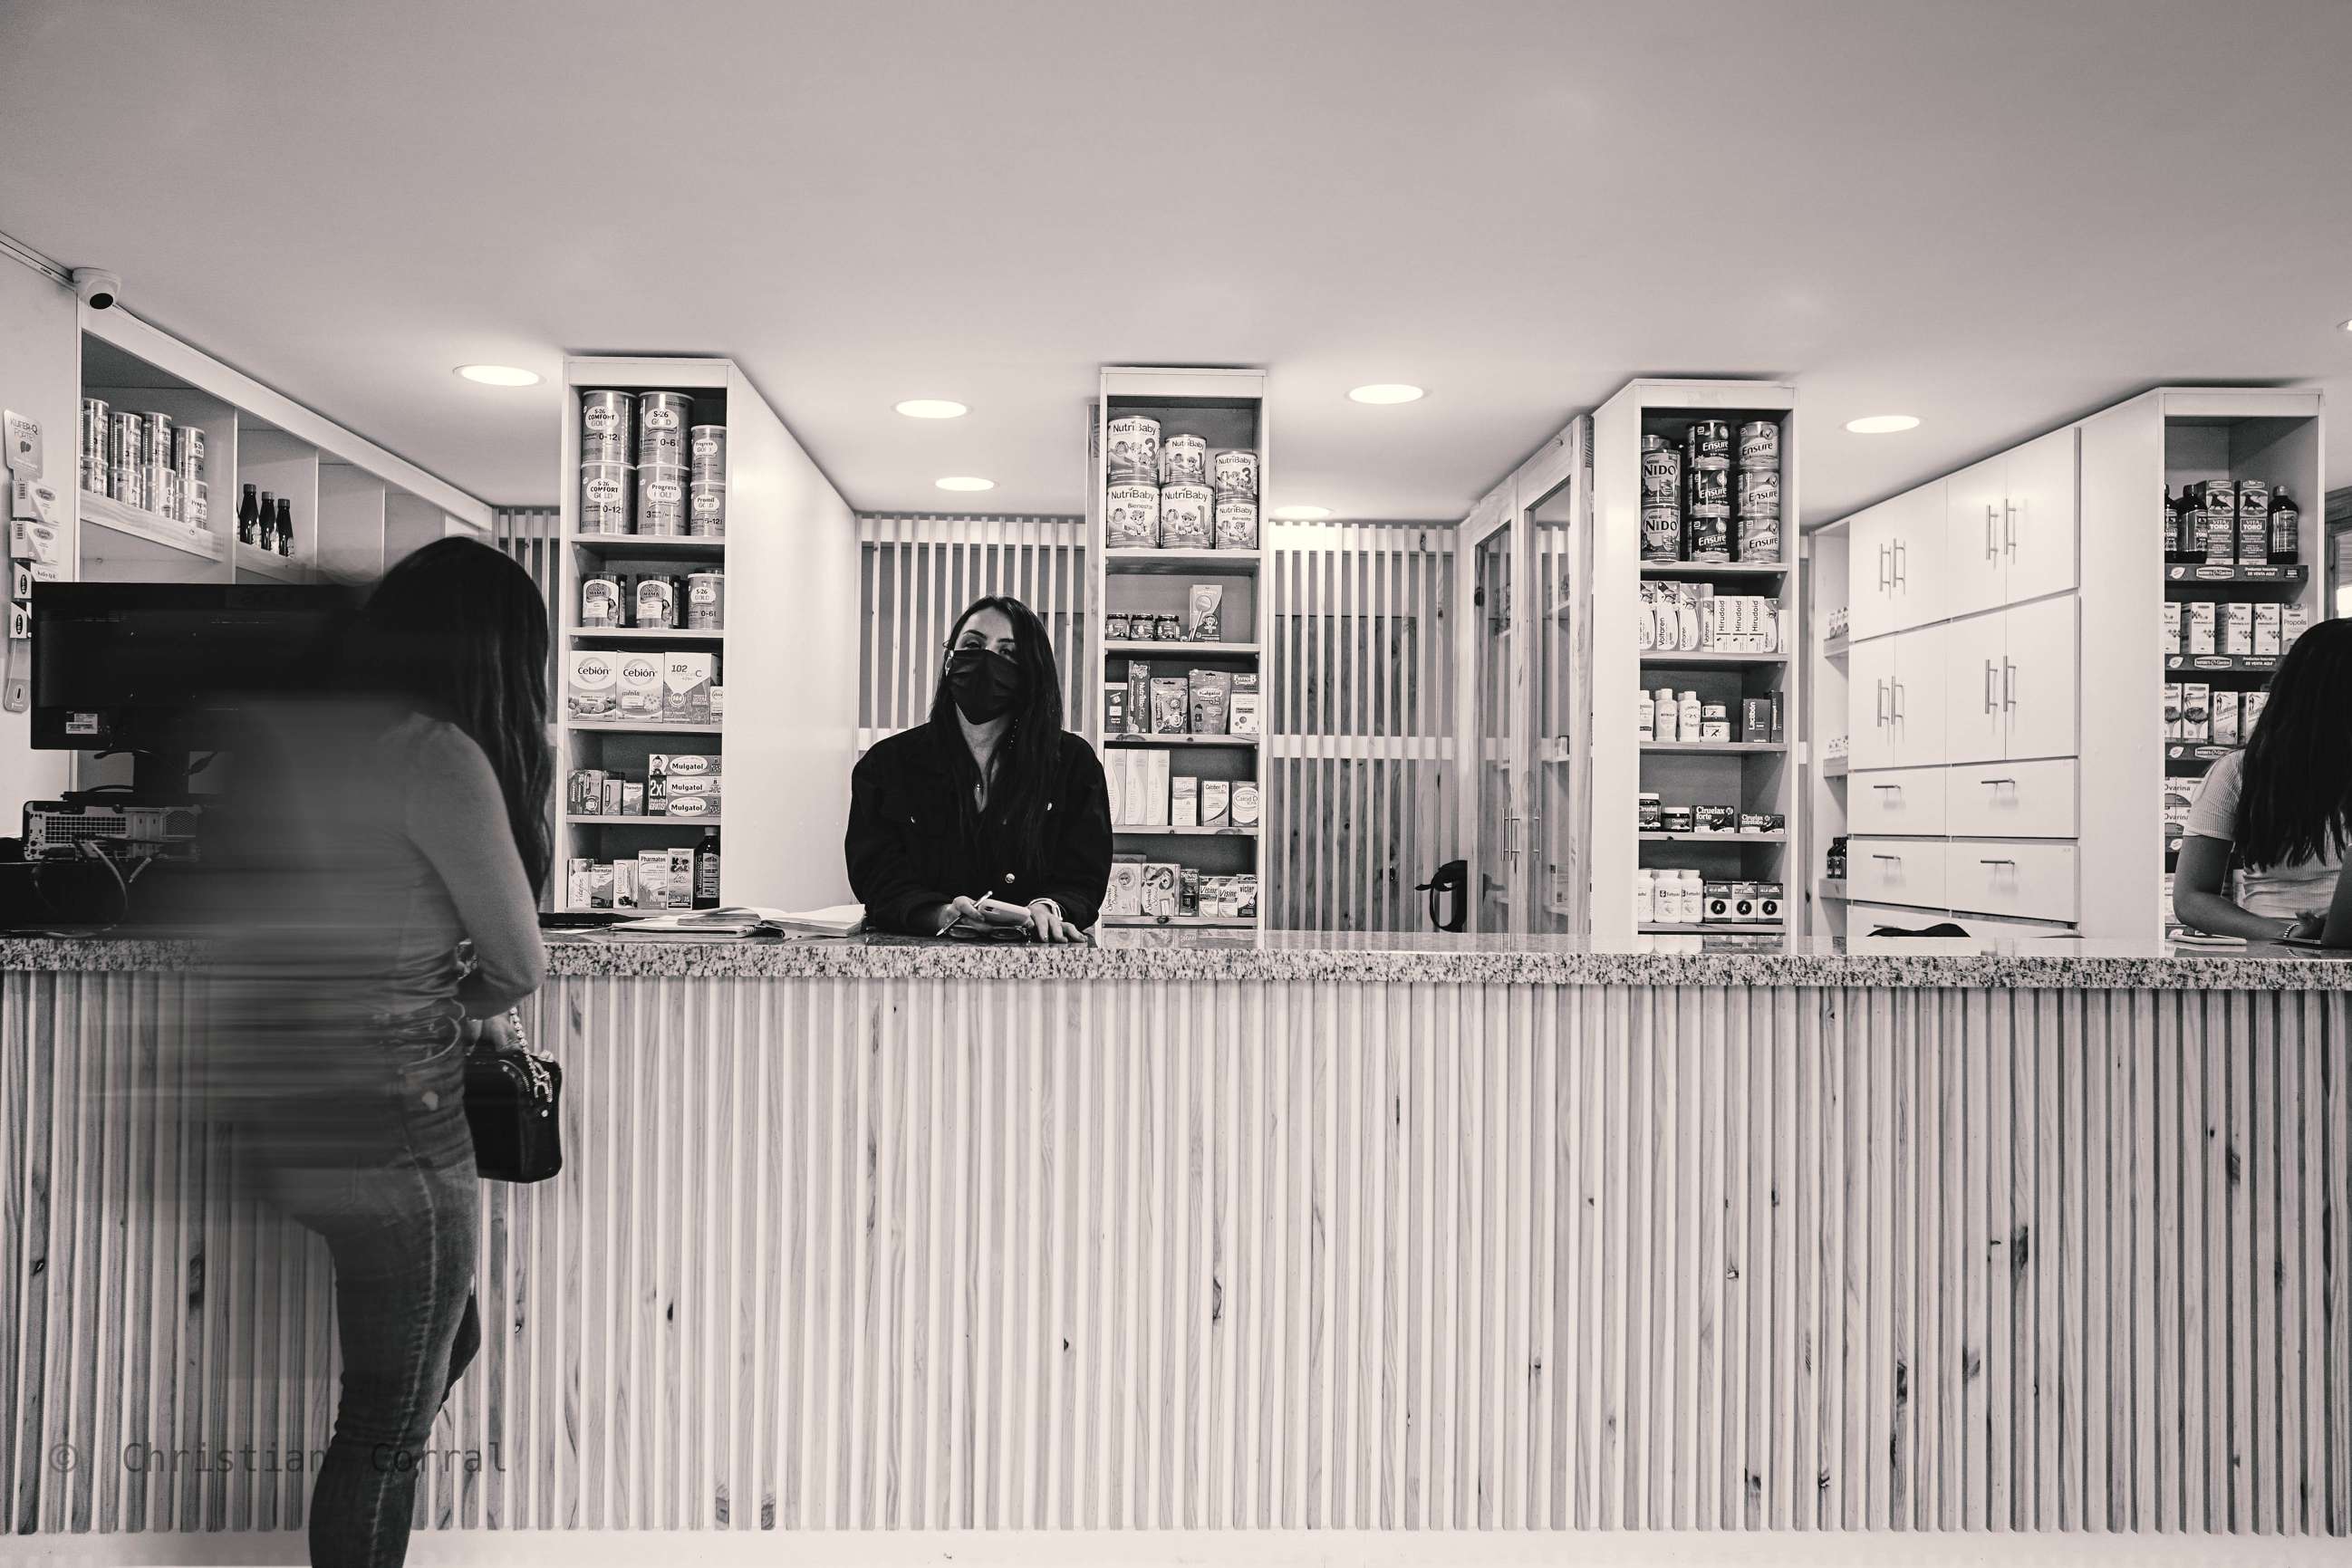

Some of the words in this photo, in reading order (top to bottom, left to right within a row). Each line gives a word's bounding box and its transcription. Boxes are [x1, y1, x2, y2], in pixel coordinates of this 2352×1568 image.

[1171, 438, 1205, 449] NutiBaby
[1742, 442, 1773, 456] Ensure
[1144, 438, 1156, 462] 3
[1219, 456, 1252, 466] NutriBaby
[1241, 467, 1252, 485] 3
[1644, 465, 1676, 477] NIDO
[1111, 487, 1154, 501] NutriBaby
[1164, 487, 1209, 501] NutriBaby
[1699, 487, 1727, 499] Ensure
[1219, 504, 1253, 515] NutriBaby
[1645, 520, 1678, 532] NIDO
[1698, 534, 1727, 545] Ensure
[1749, 537, 1778, 549] Ensure
[2283, 618, 2308, 626] Propolis
[670, 664, 688, 673] 102
[695, 669, 702, 678] C
[650, 779, 667, 796] 2x1
[1696, 806, 1725, 814] Ciruelax
[1200, 886, 1218, 894] Visine
[1219, 889, 1238, 898] Visine
